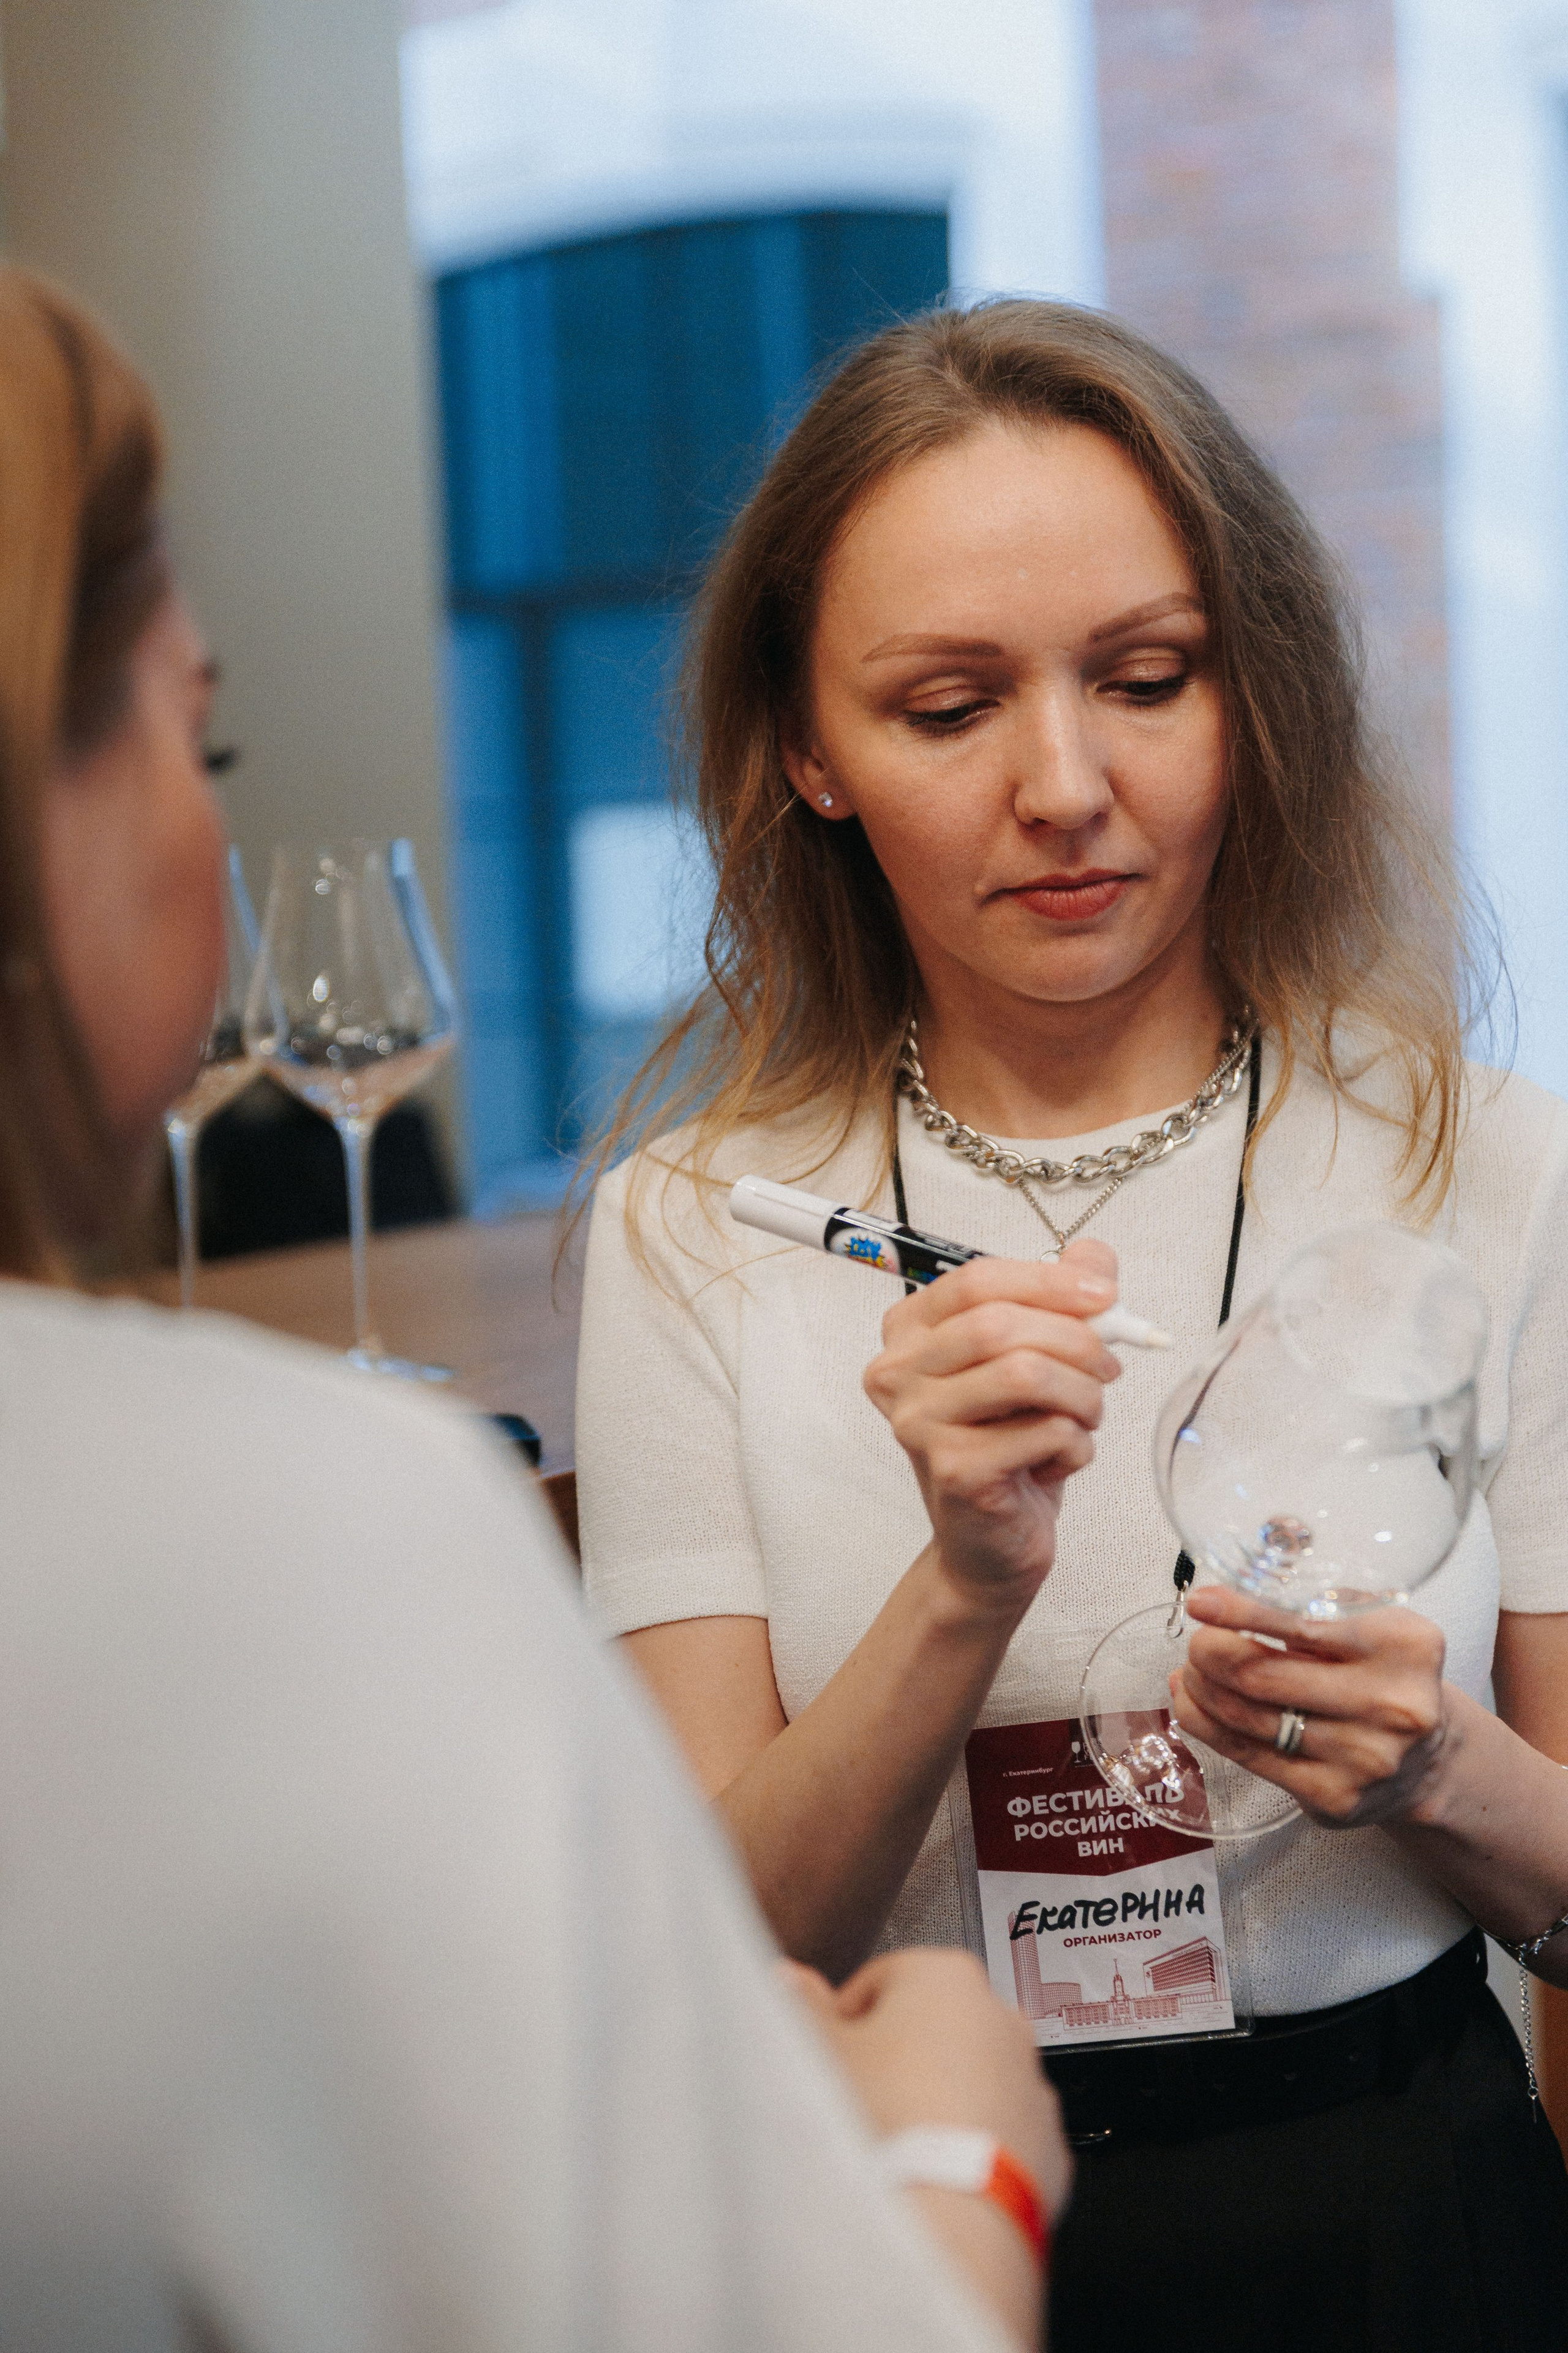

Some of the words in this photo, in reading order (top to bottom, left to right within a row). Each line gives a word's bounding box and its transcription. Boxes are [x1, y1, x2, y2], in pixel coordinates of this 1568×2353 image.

[1009, 1767, 1054, 1777] Екатеринбург
[1007, 1781, 1185, 1818] ФЕСТИВЛЬ
[1077, 1837, 1125, 1857] ВИН
[1063, 1929, 1162, 1947] ОРГАНИЗАТОР
